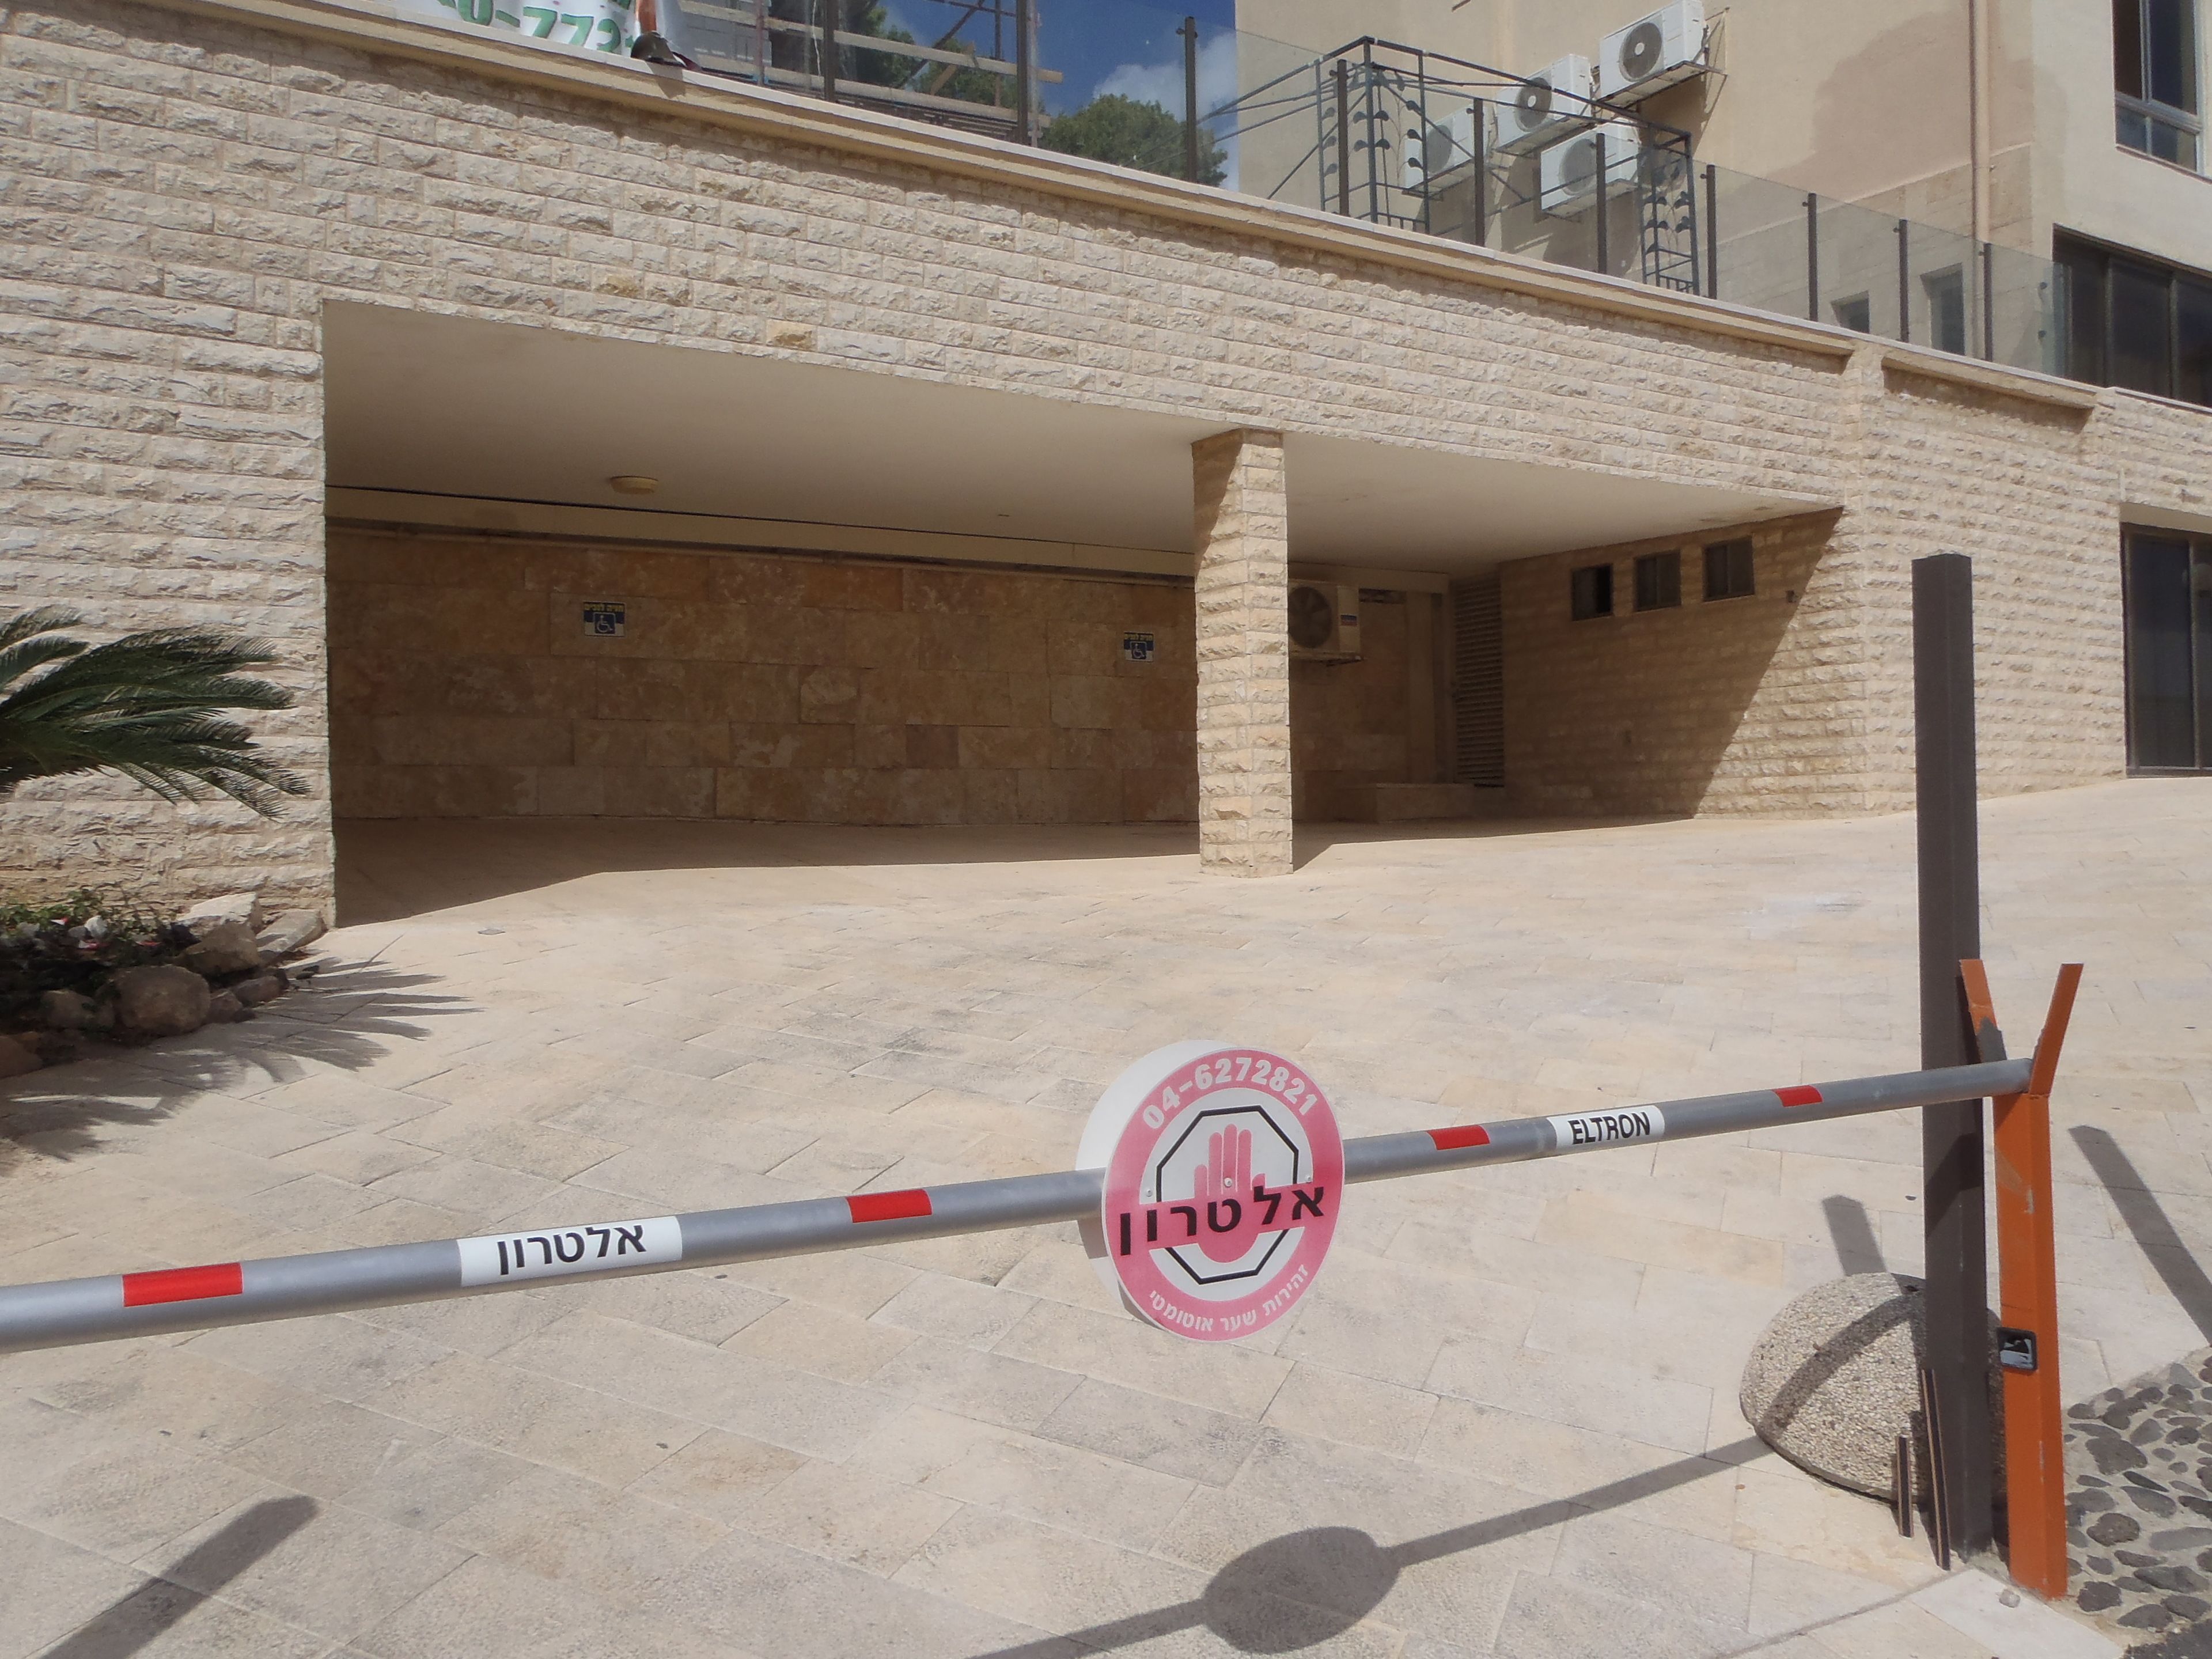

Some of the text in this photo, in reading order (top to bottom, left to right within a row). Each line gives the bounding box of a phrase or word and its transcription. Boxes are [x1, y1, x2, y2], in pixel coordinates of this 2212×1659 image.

[1143, 1057, 1317, 1128] 04-6272821
[1567, 1112, 1650, 1145] ELTRON
[498, 1225, 647, 1275] אלטרון
[1120, 1187, 1324, 1256] אלטרון
[1149, 1264, 1309, 1332] זהירות שער אוטומטי
